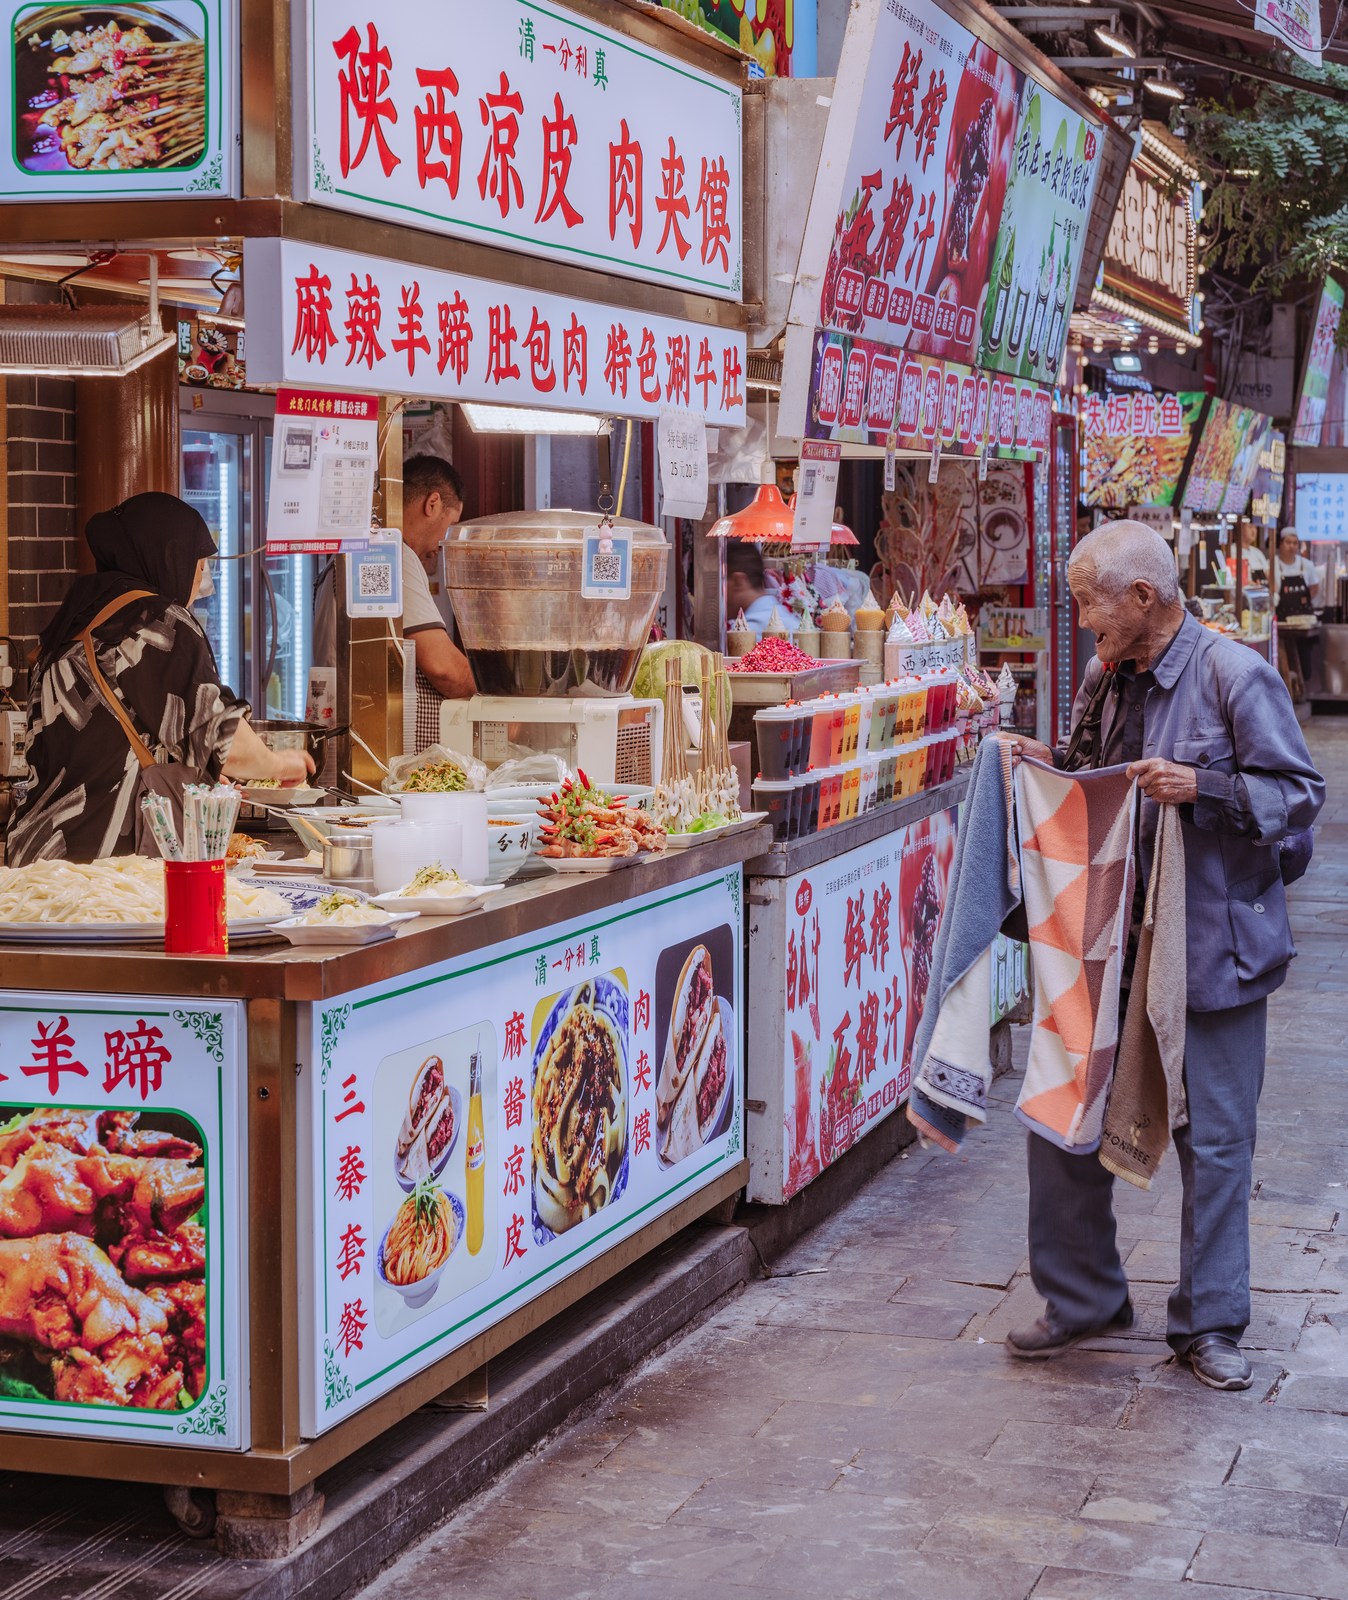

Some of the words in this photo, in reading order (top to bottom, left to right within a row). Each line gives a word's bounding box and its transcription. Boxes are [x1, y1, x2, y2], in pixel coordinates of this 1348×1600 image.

[519, 17, 535, 63] 清
[542, 37, 588, 79] 一分利
[593, 48, 609, 91] 真
[884, 40, 947, 173] 鲜榨
[332, 21, 584, 229] 陕西凉皮
[608, 118, 732, 273] 肉夹馍
[843, 167, 936, 291] 石榴汁
[291, 264, 474, 386] 麻辣羊蹄
[485, 303, 588, 396] 肚包肉
[604, 323, 744, 412] 特色涮牛肚
[535, 954, 548, 986] 清
[551, 941, 586, 974] 一分利
[588, 934, 601, 966] 真
[787, 907, 821, 1013] 西瓜汁
[843, 881, 892, 990] 鲜榨
[0, 1016, 173, 1101] 羊蹄
[632, 989, 652, 1157] 肉夹馍
[830, 975, 902, 1102] 石榴汁
[501, 1011, 528, 1270] 麻酱凉皮
[334, 1073, 368, 1358] 三秦套餐
